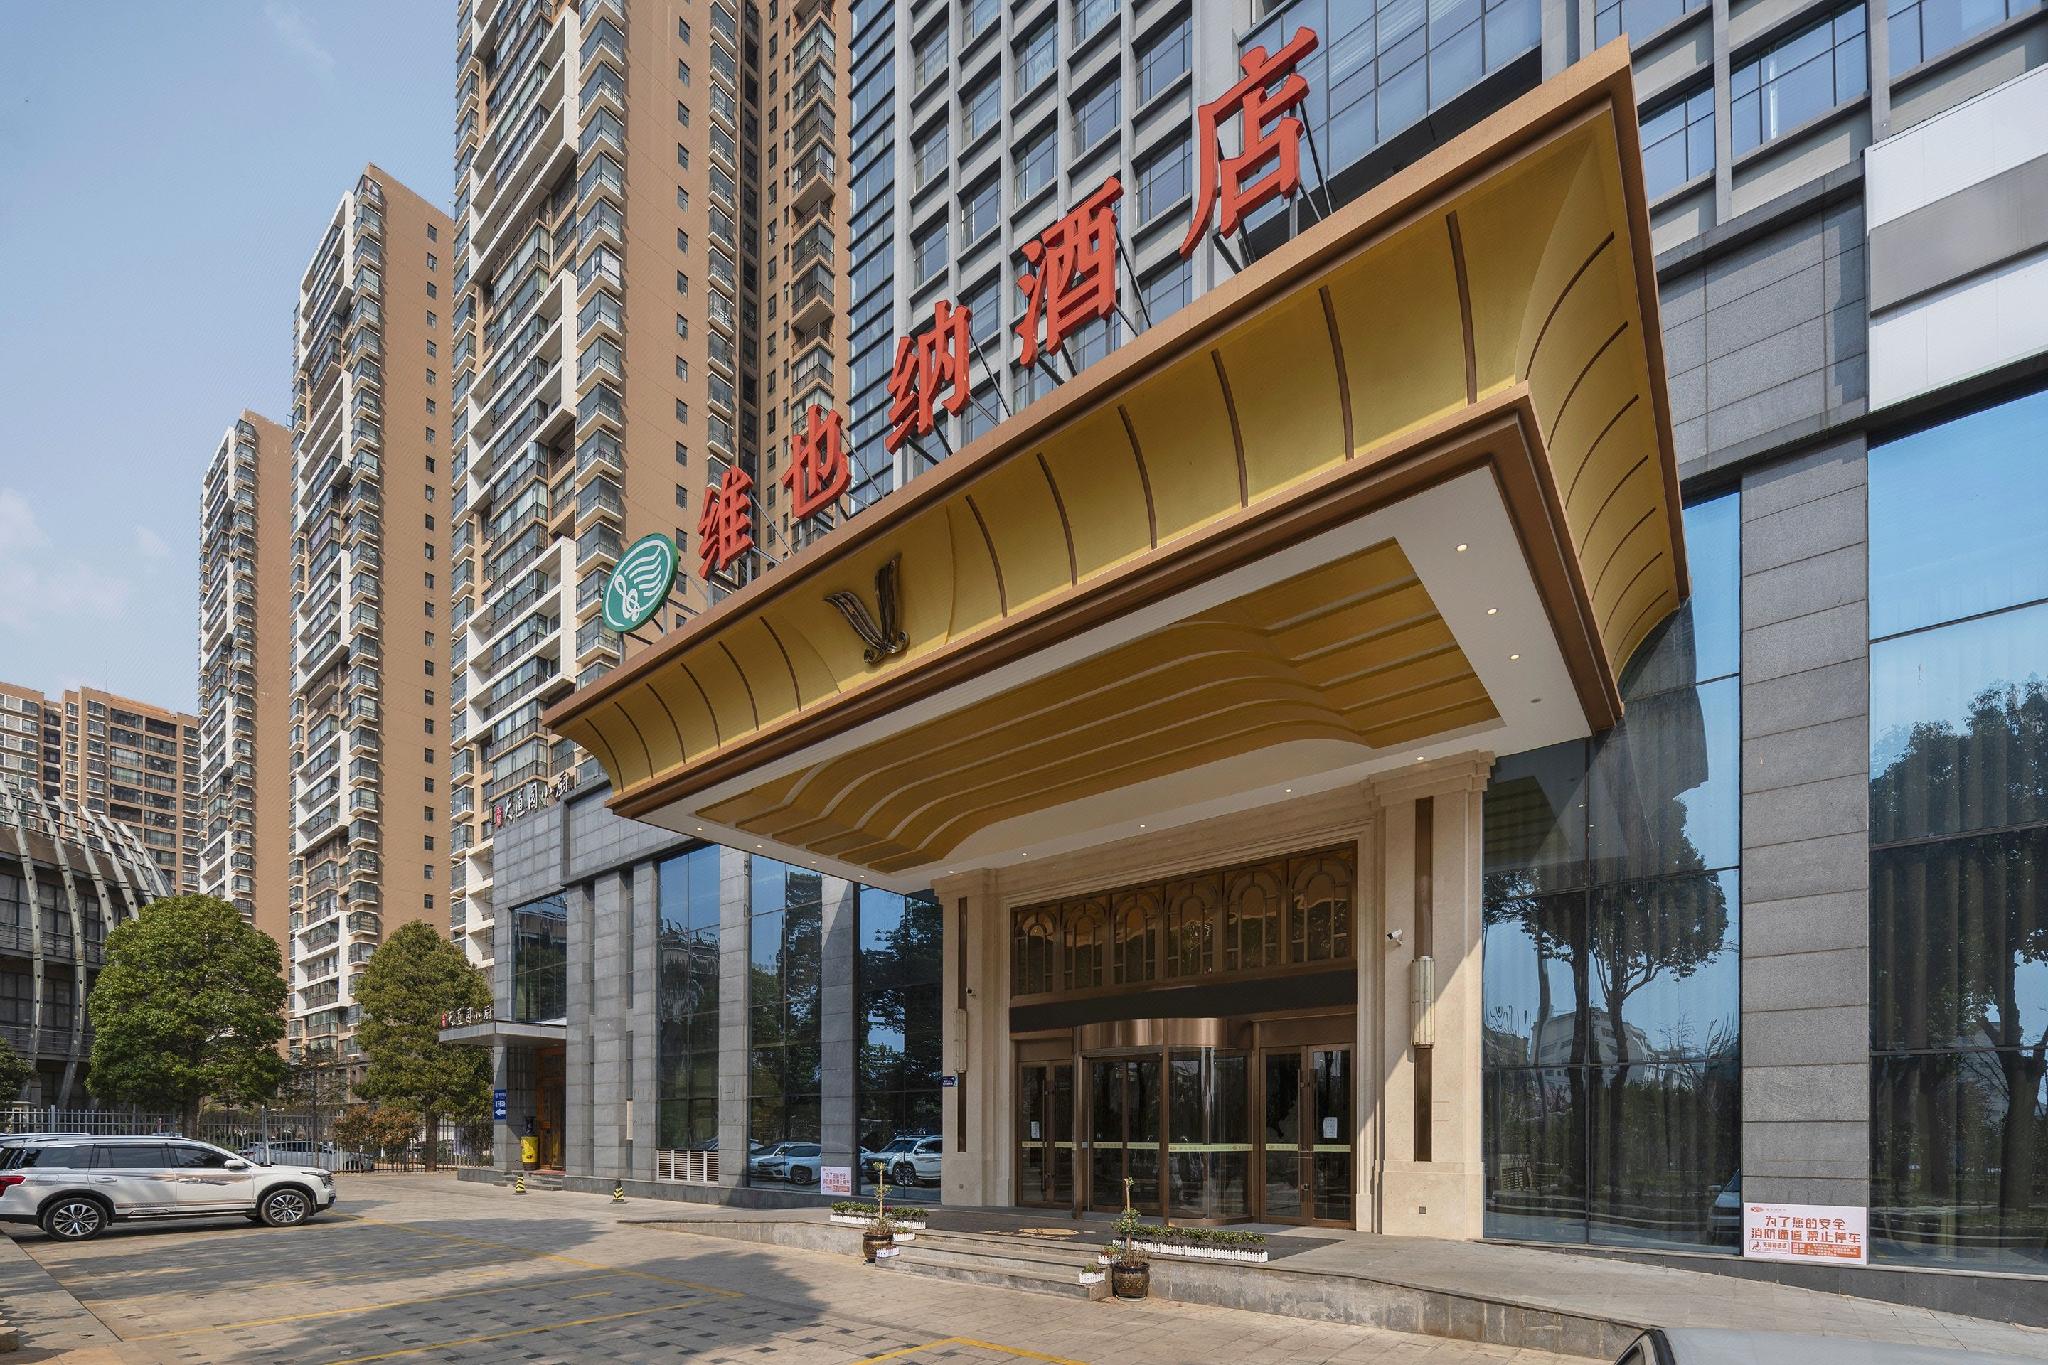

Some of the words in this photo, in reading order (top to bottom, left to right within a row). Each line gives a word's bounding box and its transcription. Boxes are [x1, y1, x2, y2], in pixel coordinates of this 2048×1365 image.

[698, 26, 1319, 580] 维也纳酒店
[1765, 1215, 1845, 1231] 为了您的安全
[1807, 1231, 1860, 1243] 禁止停车
